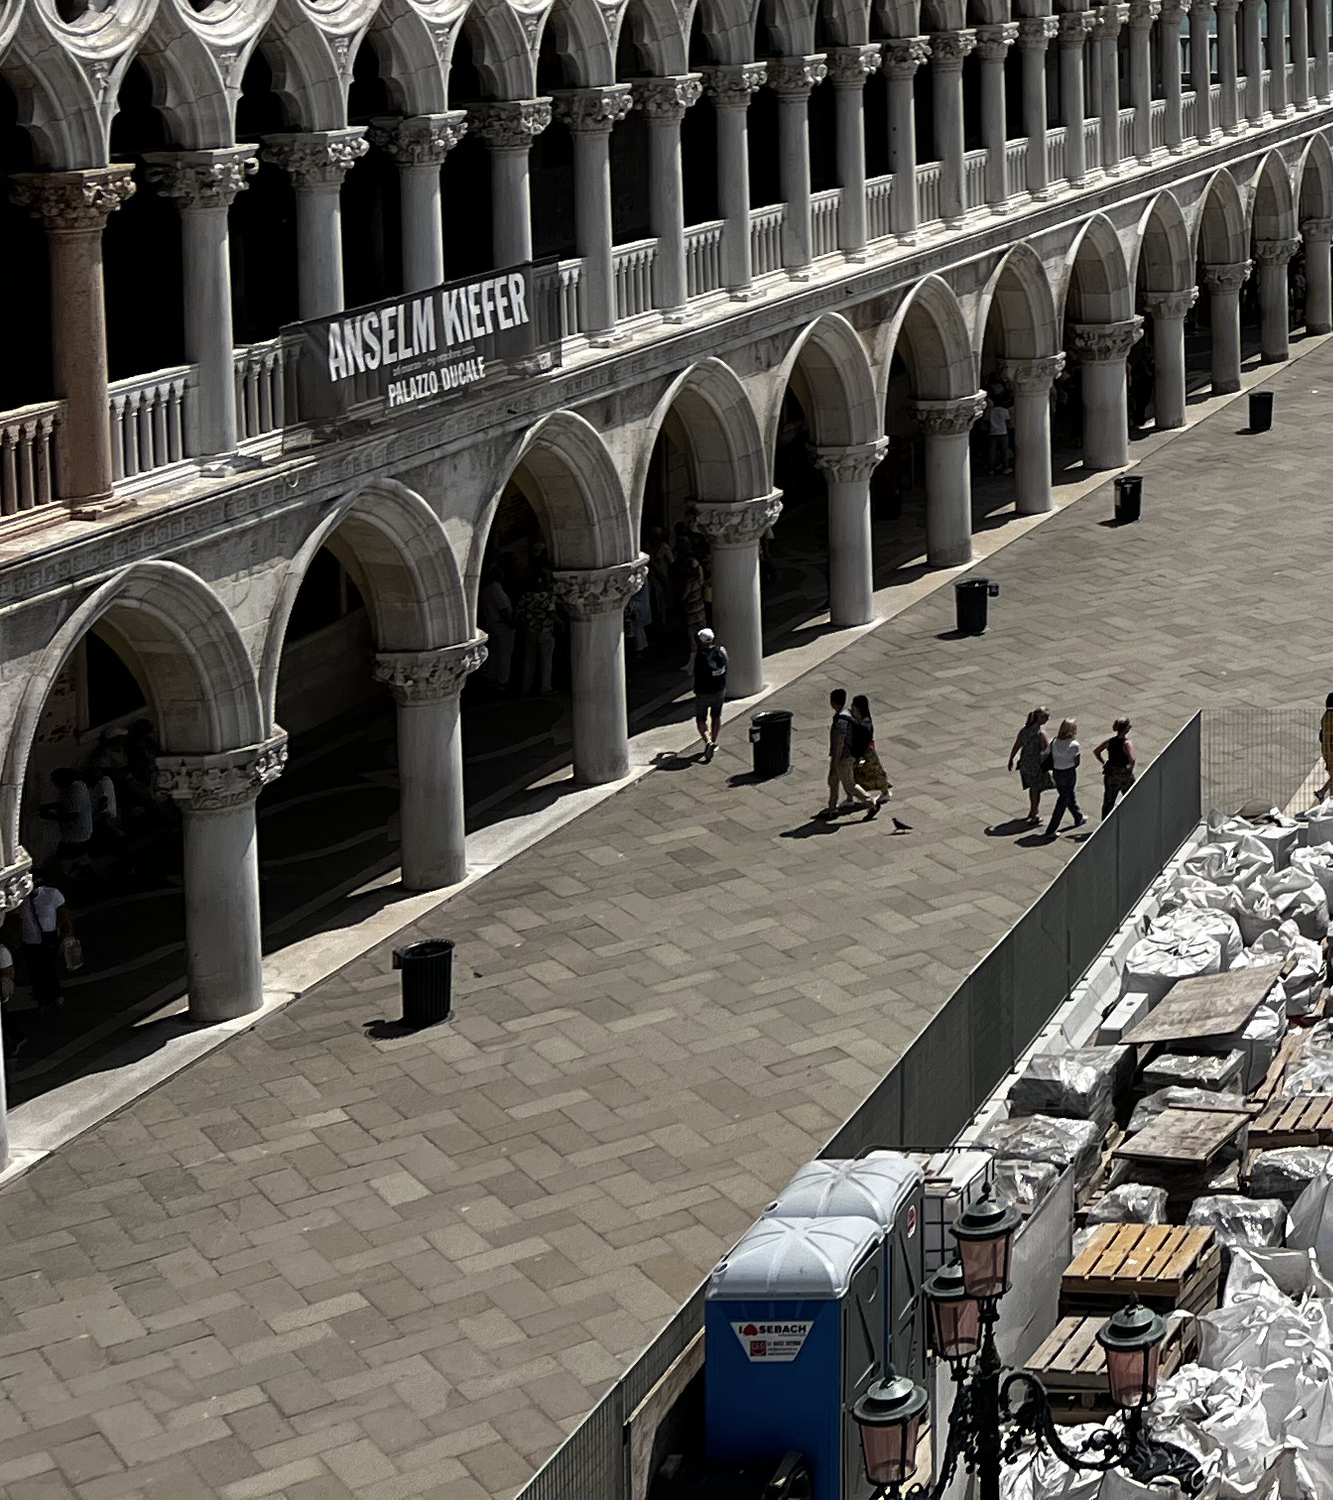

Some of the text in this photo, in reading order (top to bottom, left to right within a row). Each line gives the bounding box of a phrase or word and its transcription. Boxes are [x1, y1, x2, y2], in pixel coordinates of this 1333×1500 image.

[328, 272, 529, 382] ANSELM KIEFER
[388, 370, 438, 408] PALAZZO
[440, 355, 487, 391] DUCALE
[759, 1325, 806, 1334] SEBACH
